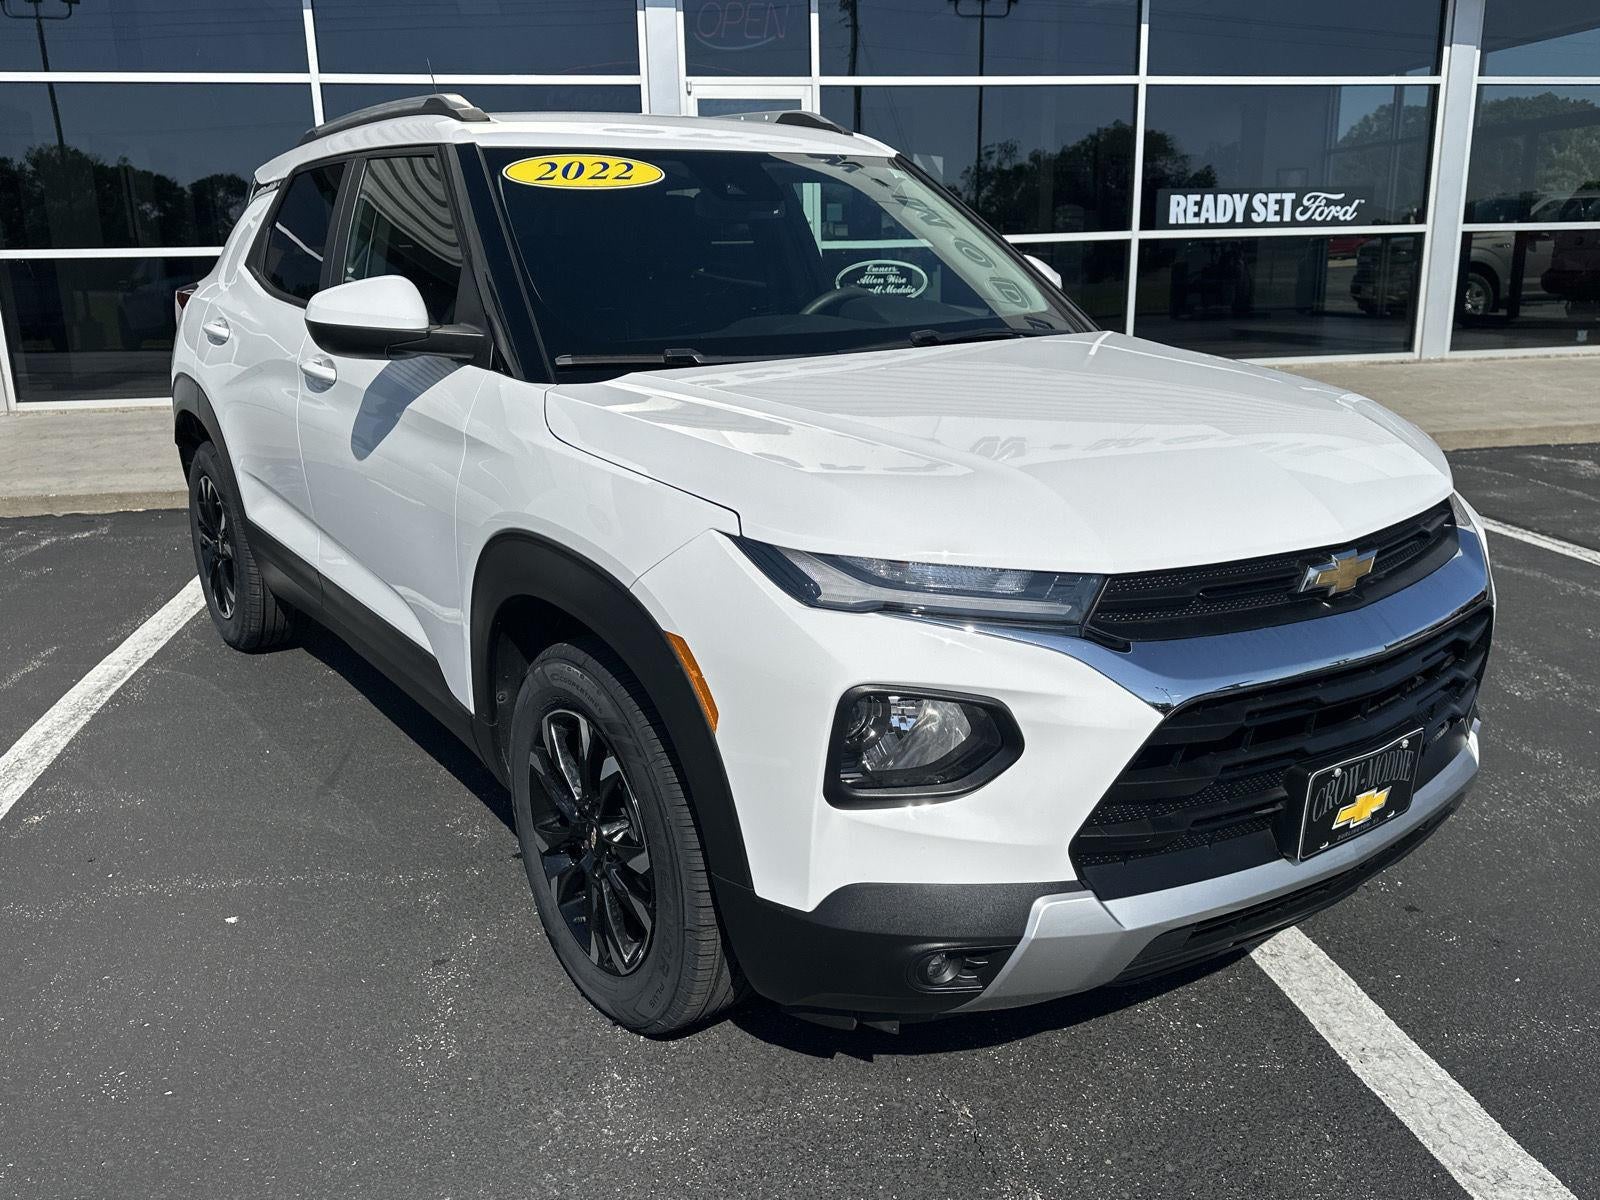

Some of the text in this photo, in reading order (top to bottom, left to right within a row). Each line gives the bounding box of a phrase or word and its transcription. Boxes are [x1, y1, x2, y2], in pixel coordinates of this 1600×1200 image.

[697, 2, 786, 38] OPEN
[534, 161, 634, 181] 2022
[1169, 191, 1362, 224] READY SET Ford
[857, 274, 907, 284] Allen Wise
